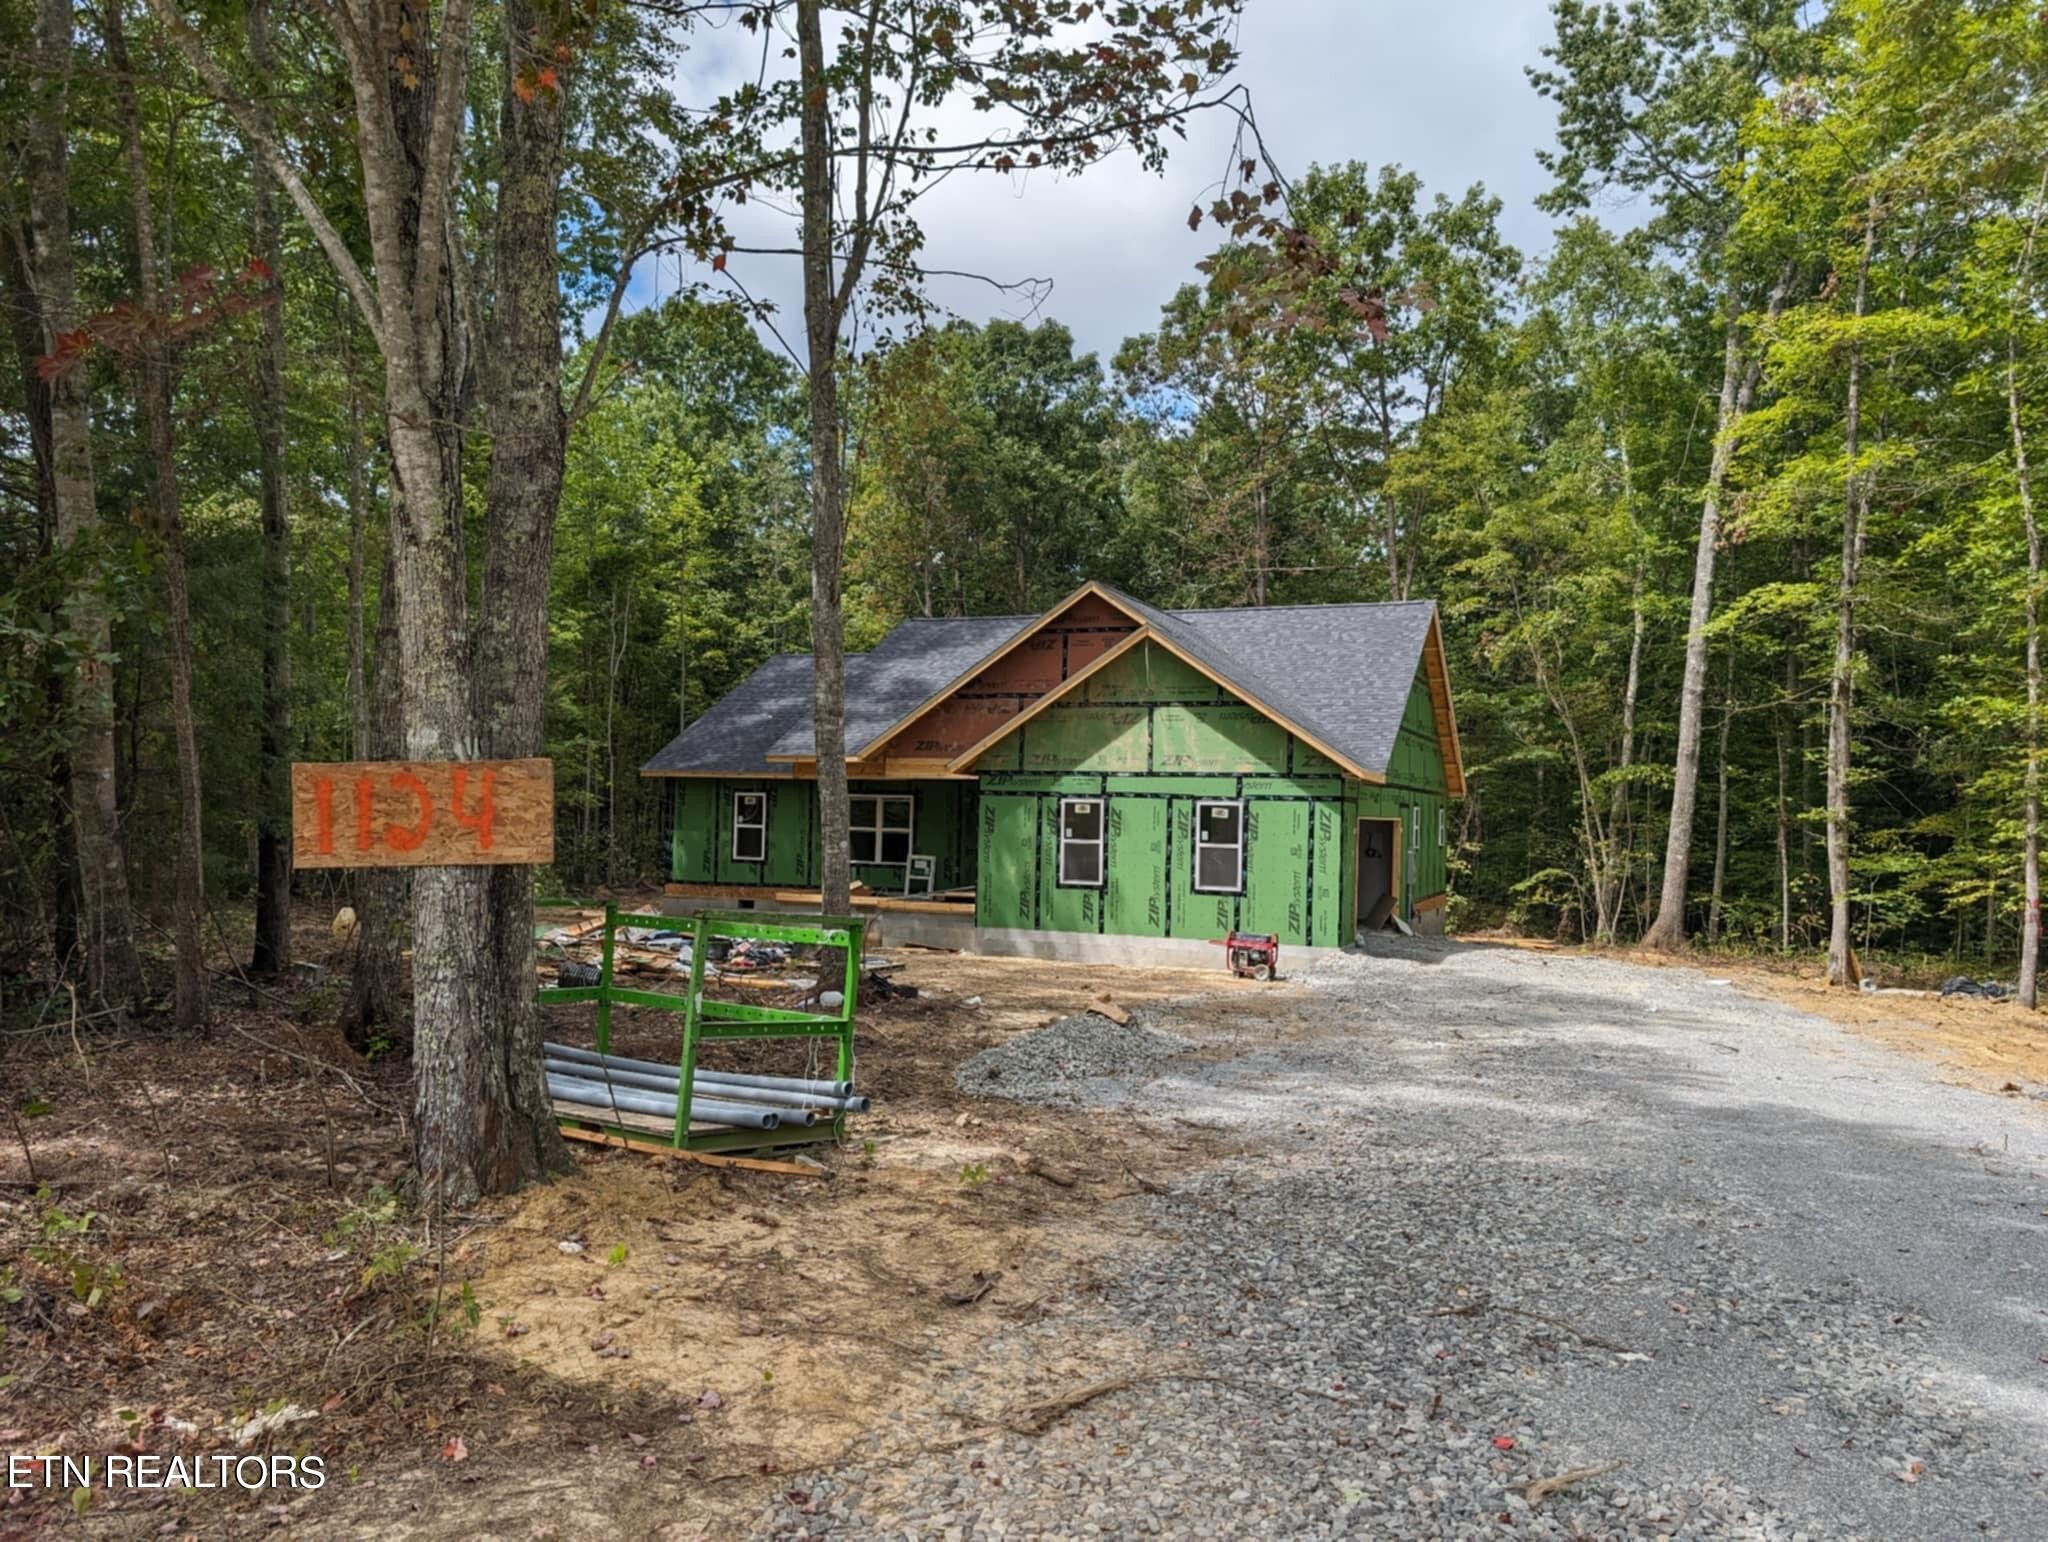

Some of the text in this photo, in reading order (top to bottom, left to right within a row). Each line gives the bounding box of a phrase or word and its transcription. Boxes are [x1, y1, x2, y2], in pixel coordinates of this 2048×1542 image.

[984, 804, 996, 833] ZIP
[1110, 807, 1122, 837] ZIP
[1177, 808, 1189, 840] ZIP
[1248, 810, 1259, 841] ZIP
[1320, 808, 1332, 841] ZIP
[1020, 889, 1031, 920] ZIP
[1083, 892, 1094, 924] ZIP
[1148, 896, 1160, 928] ZIP
[1217, 899, 1229, 932] ZIP
[1288, 903, 1301, 935] ZIP
